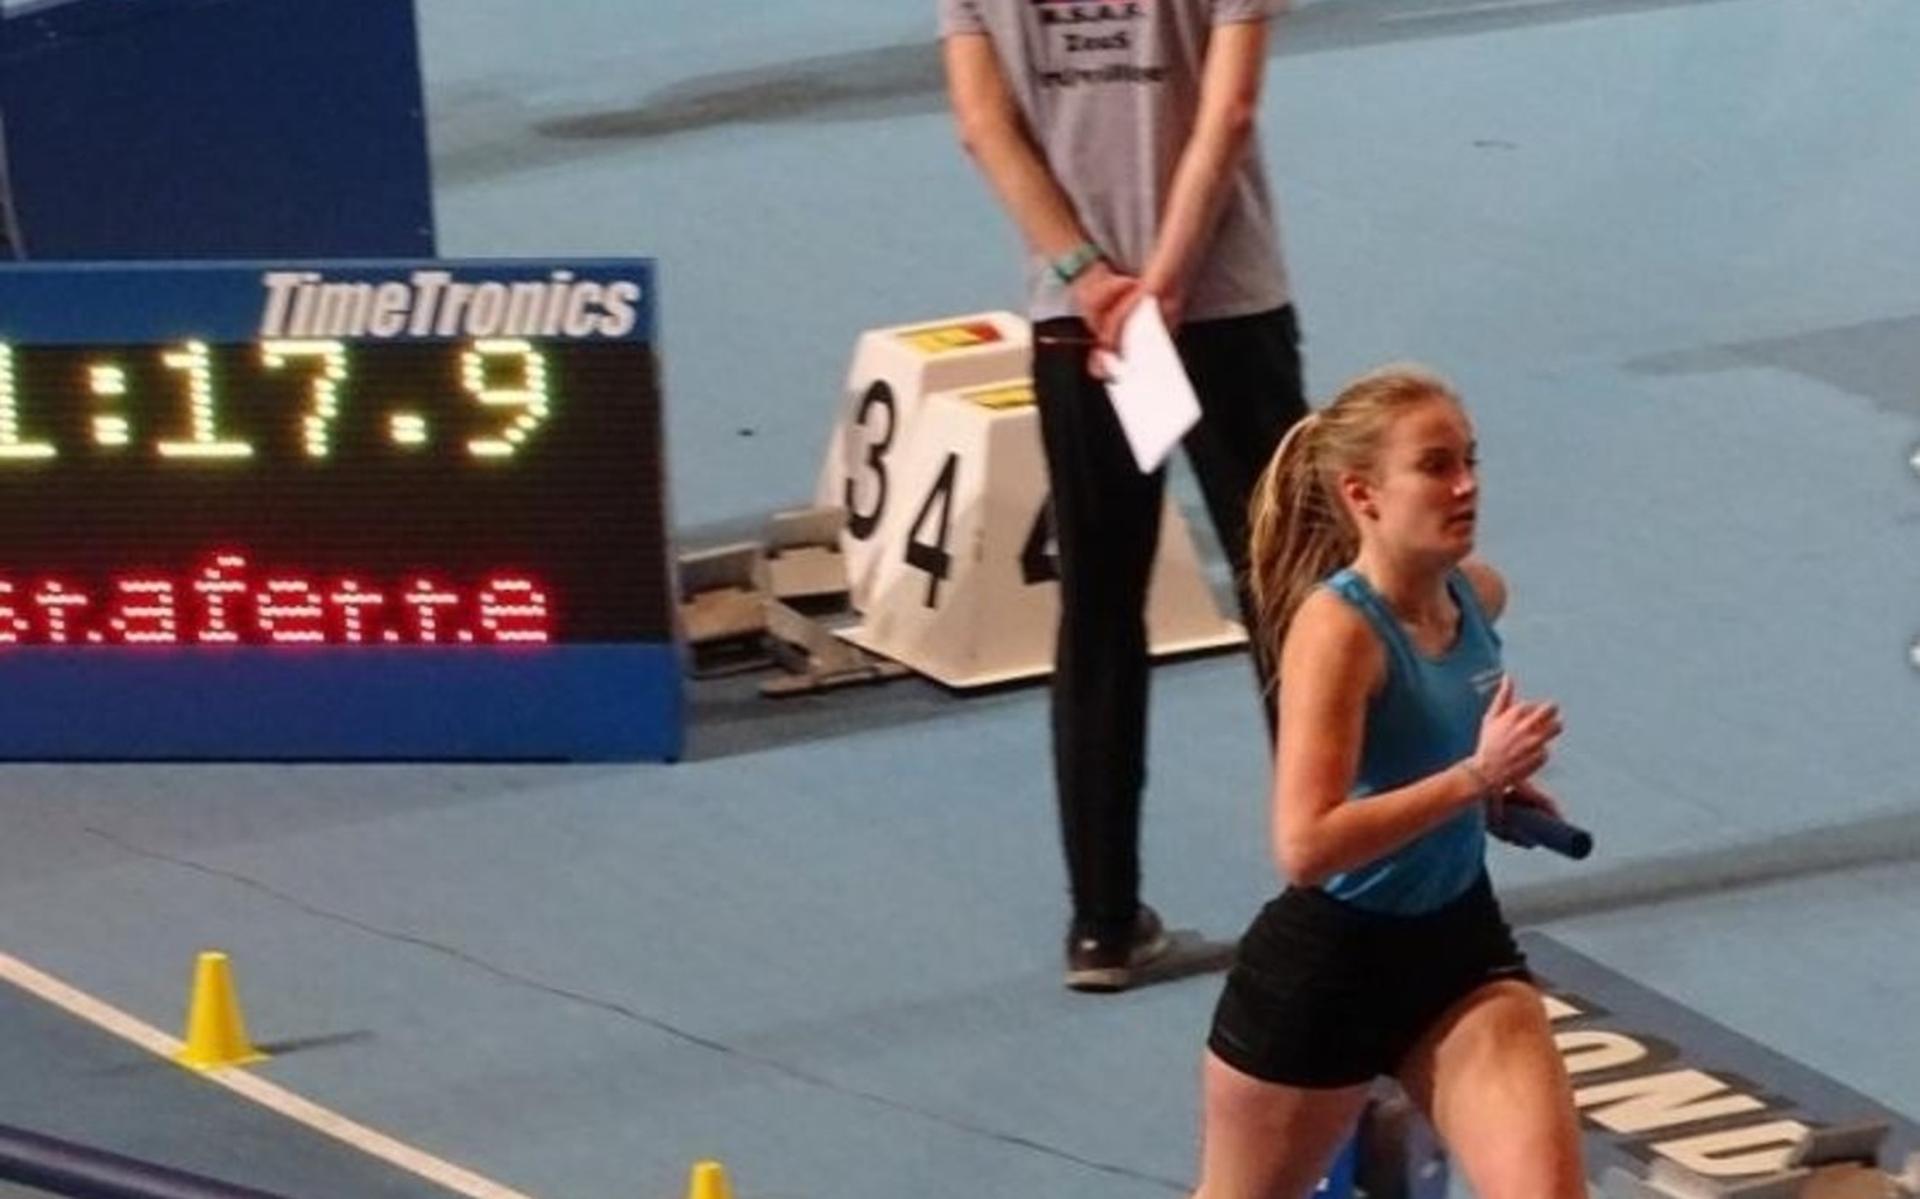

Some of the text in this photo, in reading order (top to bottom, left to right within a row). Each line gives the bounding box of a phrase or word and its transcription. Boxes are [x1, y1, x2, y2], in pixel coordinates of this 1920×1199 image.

[259, 271, 641, 338] TimeTronics
[846, 380, 895, 540] 3
[905, 453, 959, 609] 4
